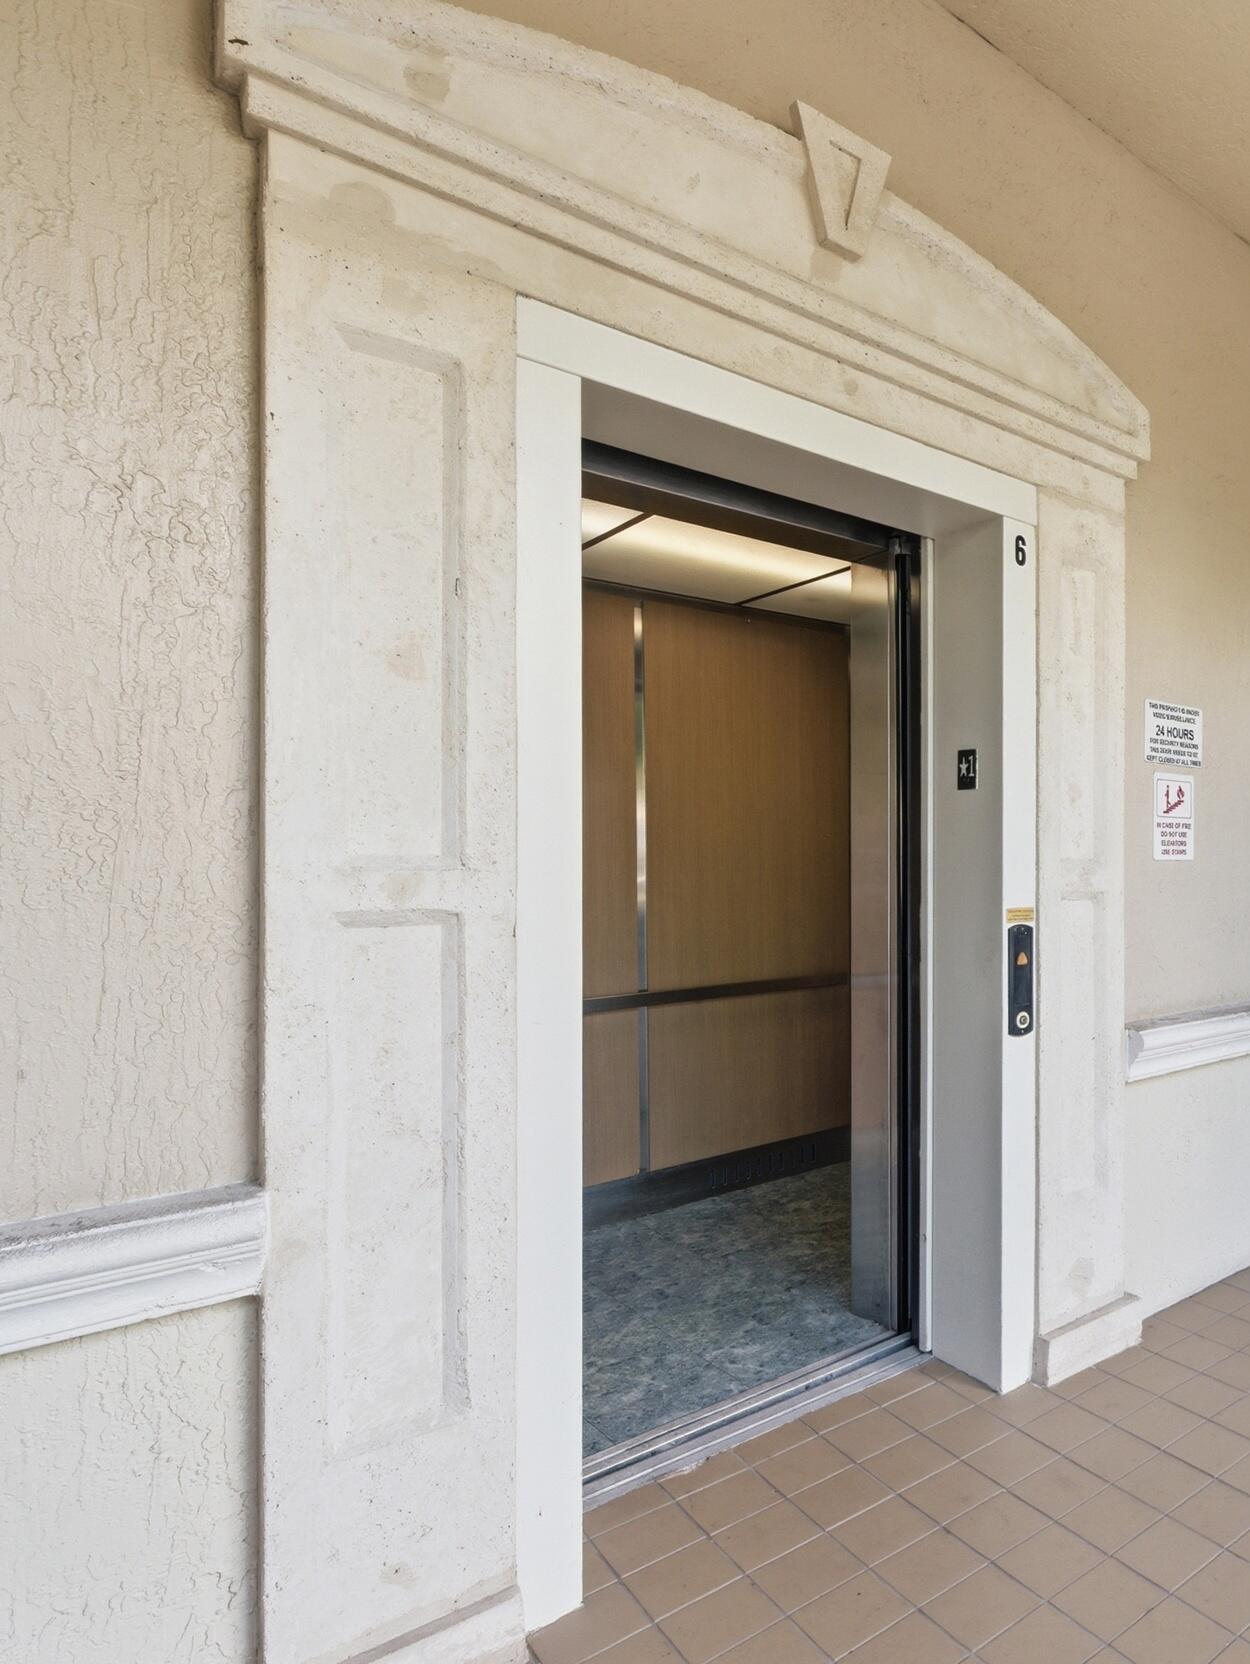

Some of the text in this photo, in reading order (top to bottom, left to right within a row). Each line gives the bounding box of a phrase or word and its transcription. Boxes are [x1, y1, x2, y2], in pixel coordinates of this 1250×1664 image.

[1015, 534, 1026, 566] 6
[1156, 725, 1194, 741] 24 HOURS
[968, 755, 975, 776] 1
